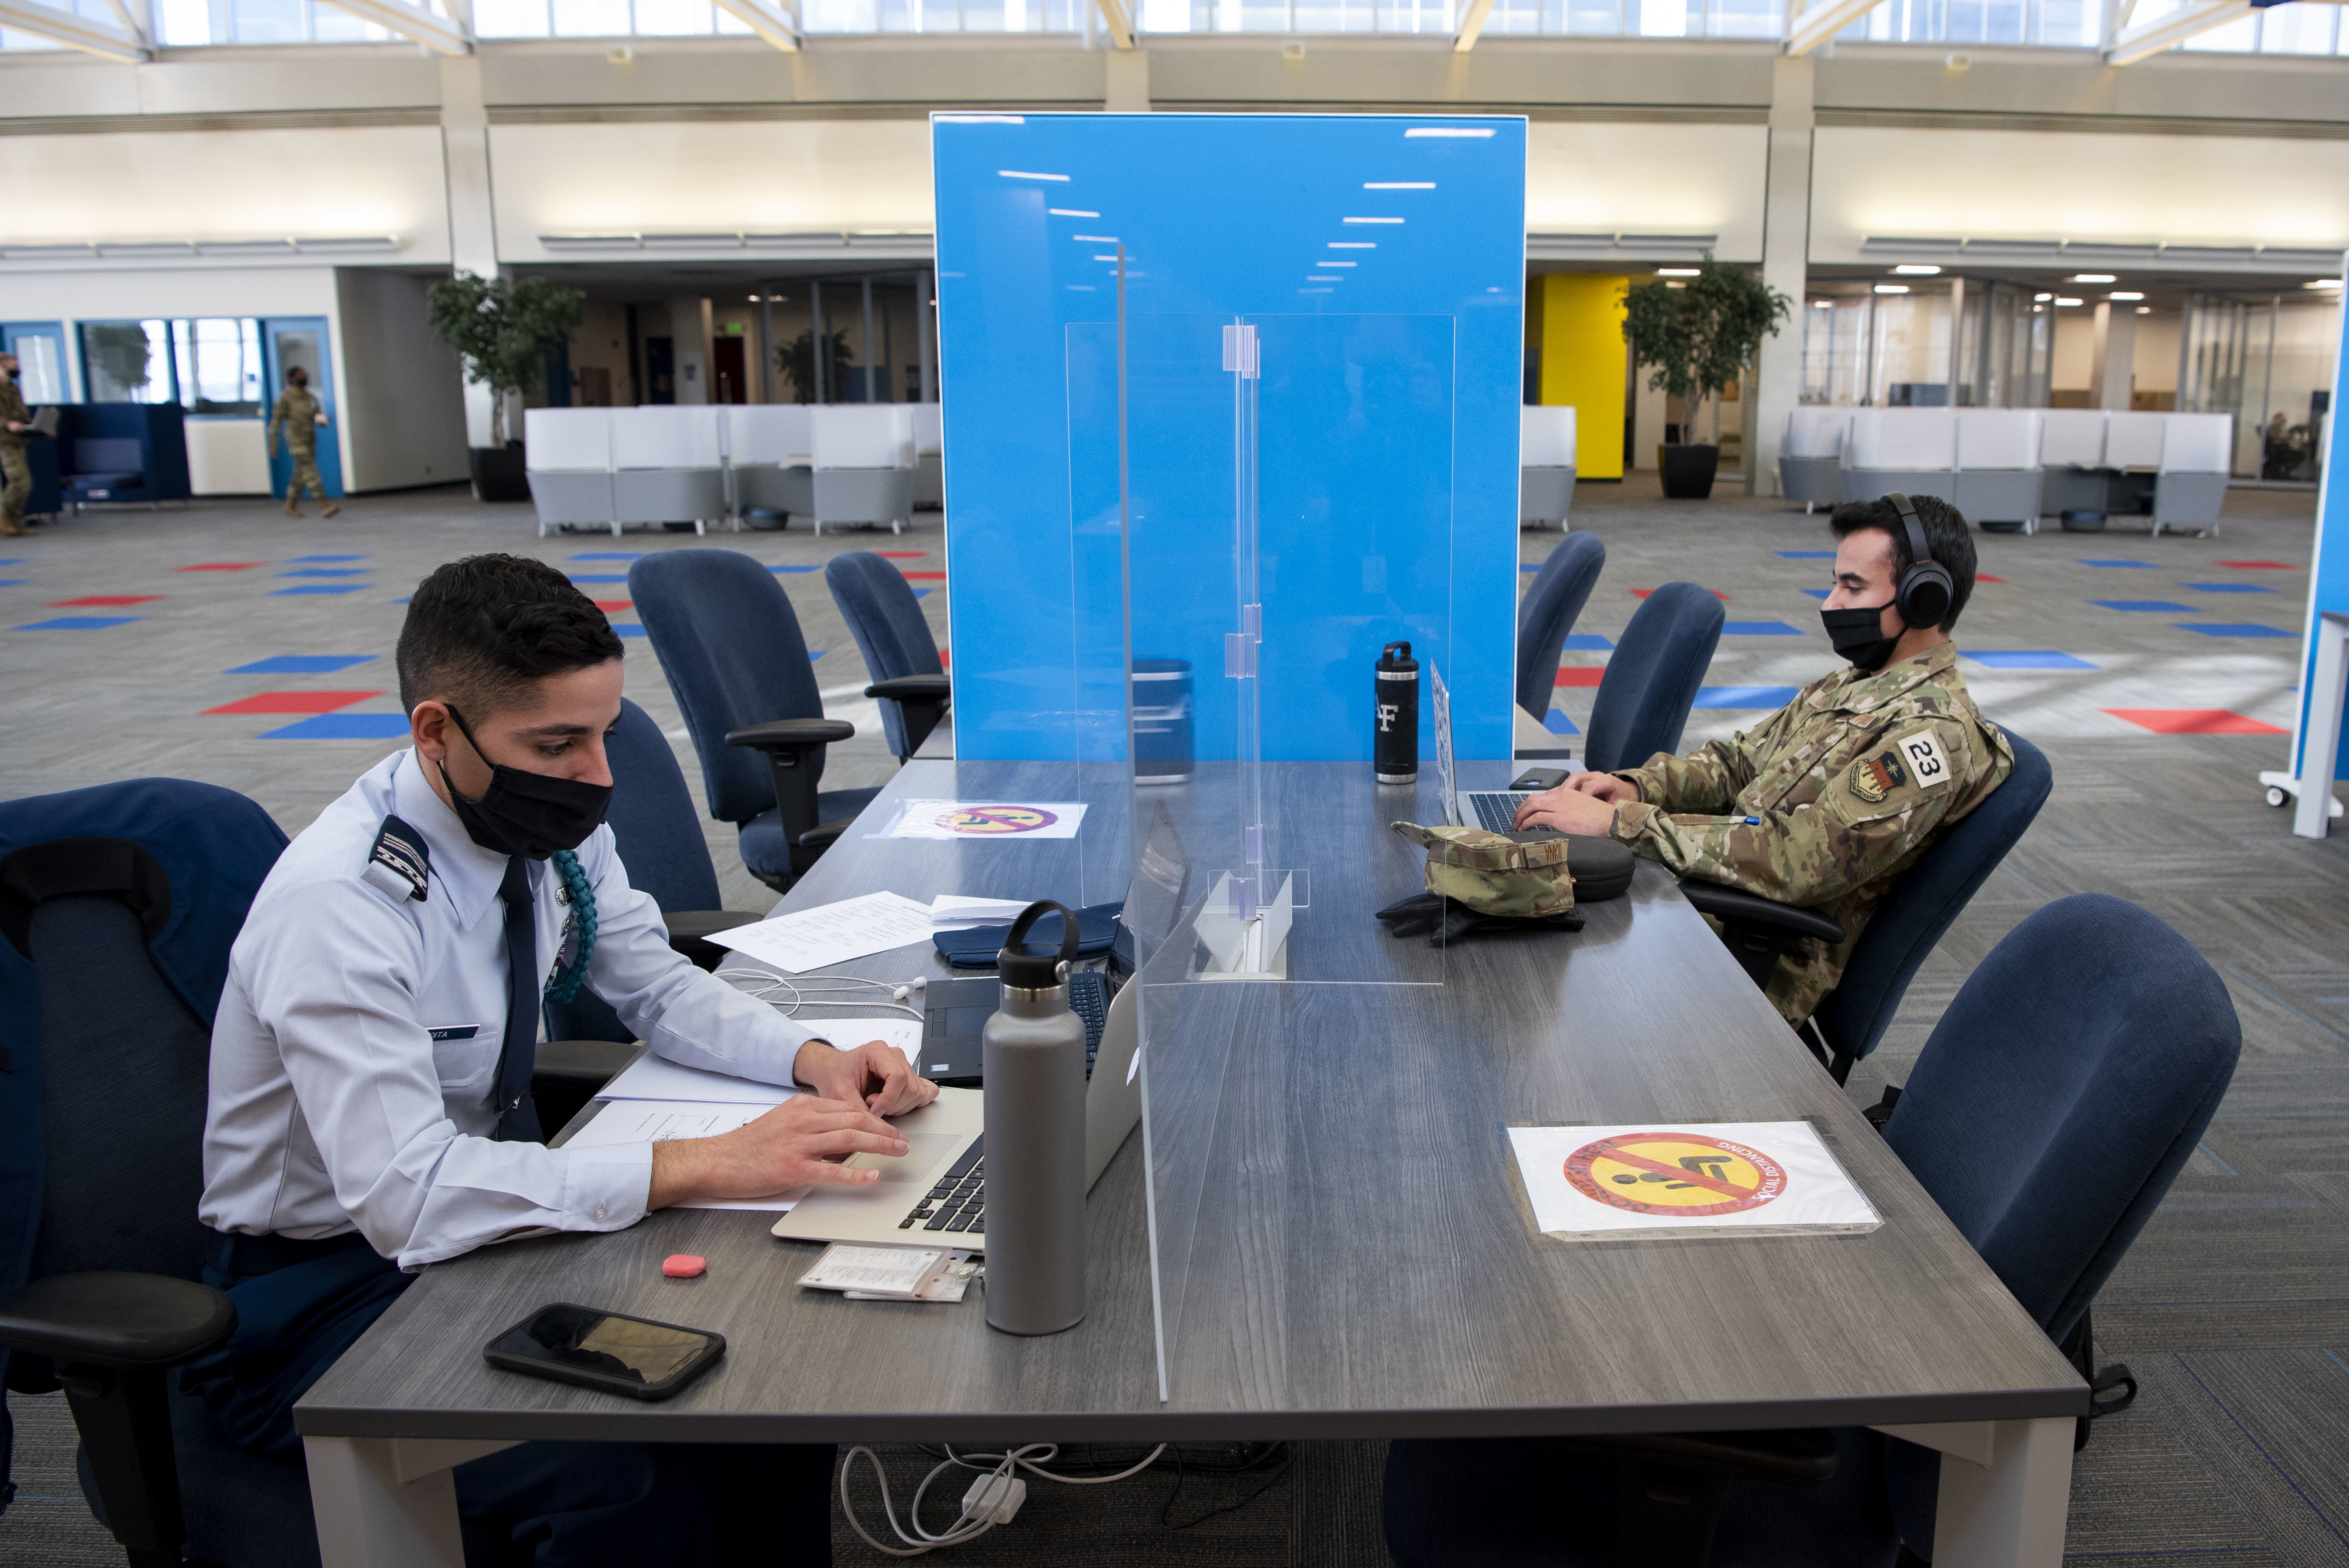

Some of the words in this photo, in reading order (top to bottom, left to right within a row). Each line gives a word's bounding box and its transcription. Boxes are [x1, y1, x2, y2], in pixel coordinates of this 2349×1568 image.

[1909, 741, 1941, 776] 23
[1573, 1139, 1624, 1161] HERE
[1716, 1142, 1779, 1177] DISTANCING
[1567, 1161, 1589, 1177] SIT
[1571, 1179, 1614, 1200] NOT
[1751, 1177, 1780, 1201] SOCIAL
[1611, 1199, 1651, 1212] DO
